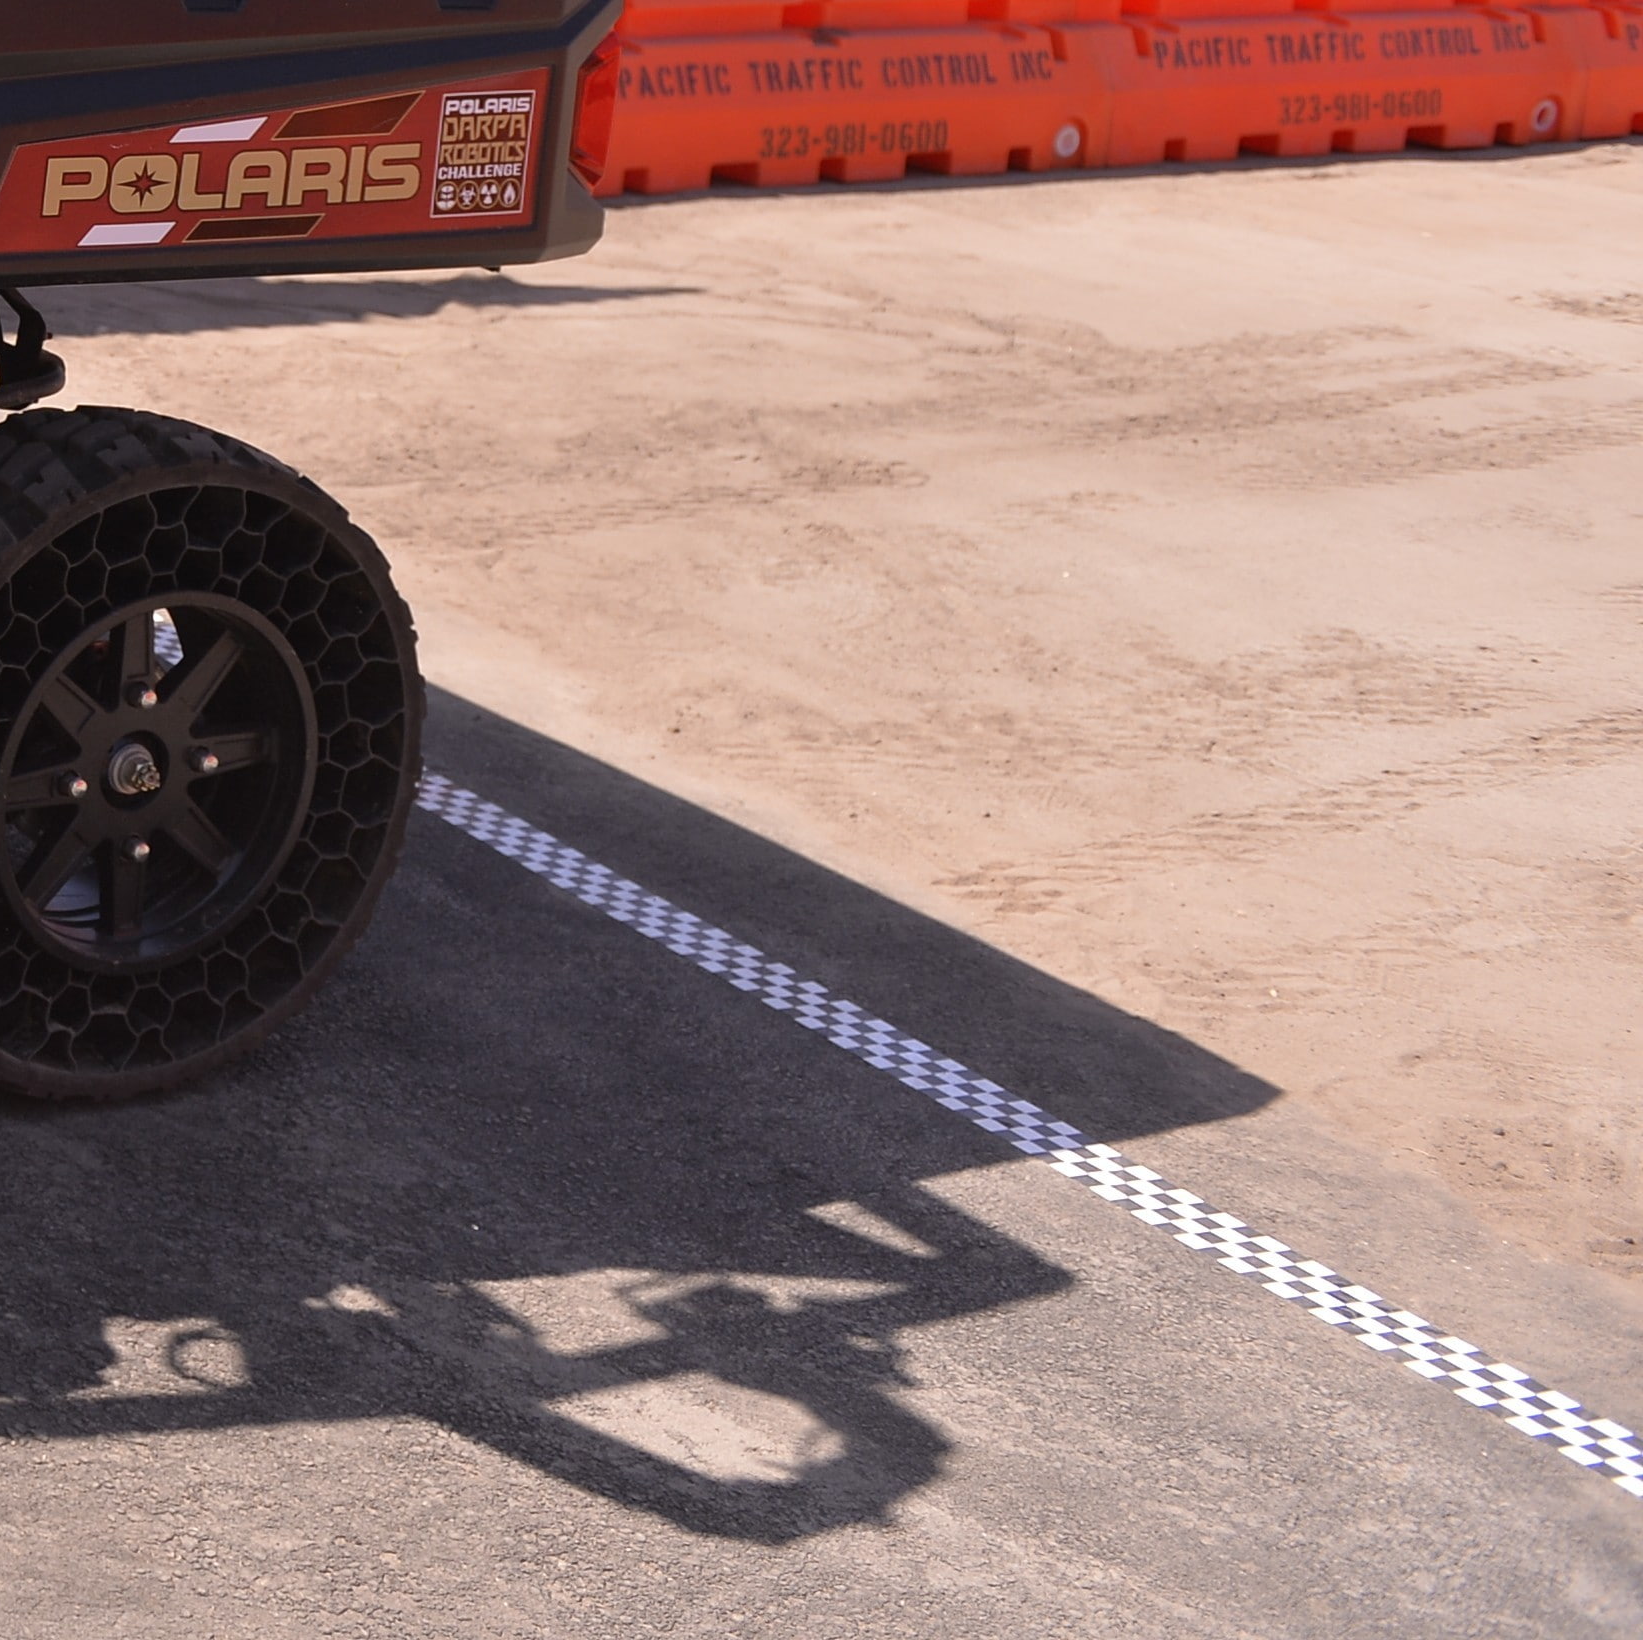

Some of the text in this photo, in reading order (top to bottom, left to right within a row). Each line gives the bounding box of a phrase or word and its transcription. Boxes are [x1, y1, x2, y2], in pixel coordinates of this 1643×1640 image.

[1152, 23, 1531, 70] PACIFIC TRAFFIC CONTROL INC
[617, 50, 1053, 100] PACIFIC TRAFFIC CONTROL INC
[445, 97, 531, 116] POLARIS
[1278, 89, 1444, 127] 323-981-0600
[441, 114, 526, 142] DARPA
[758, 120, 950, 159] 323-981-0600
[437, 163, 523, 180] CHALLENGE
[439, 141, 527, 165] ROBOTICS
[41, 143, 422, 217] POLARIS
